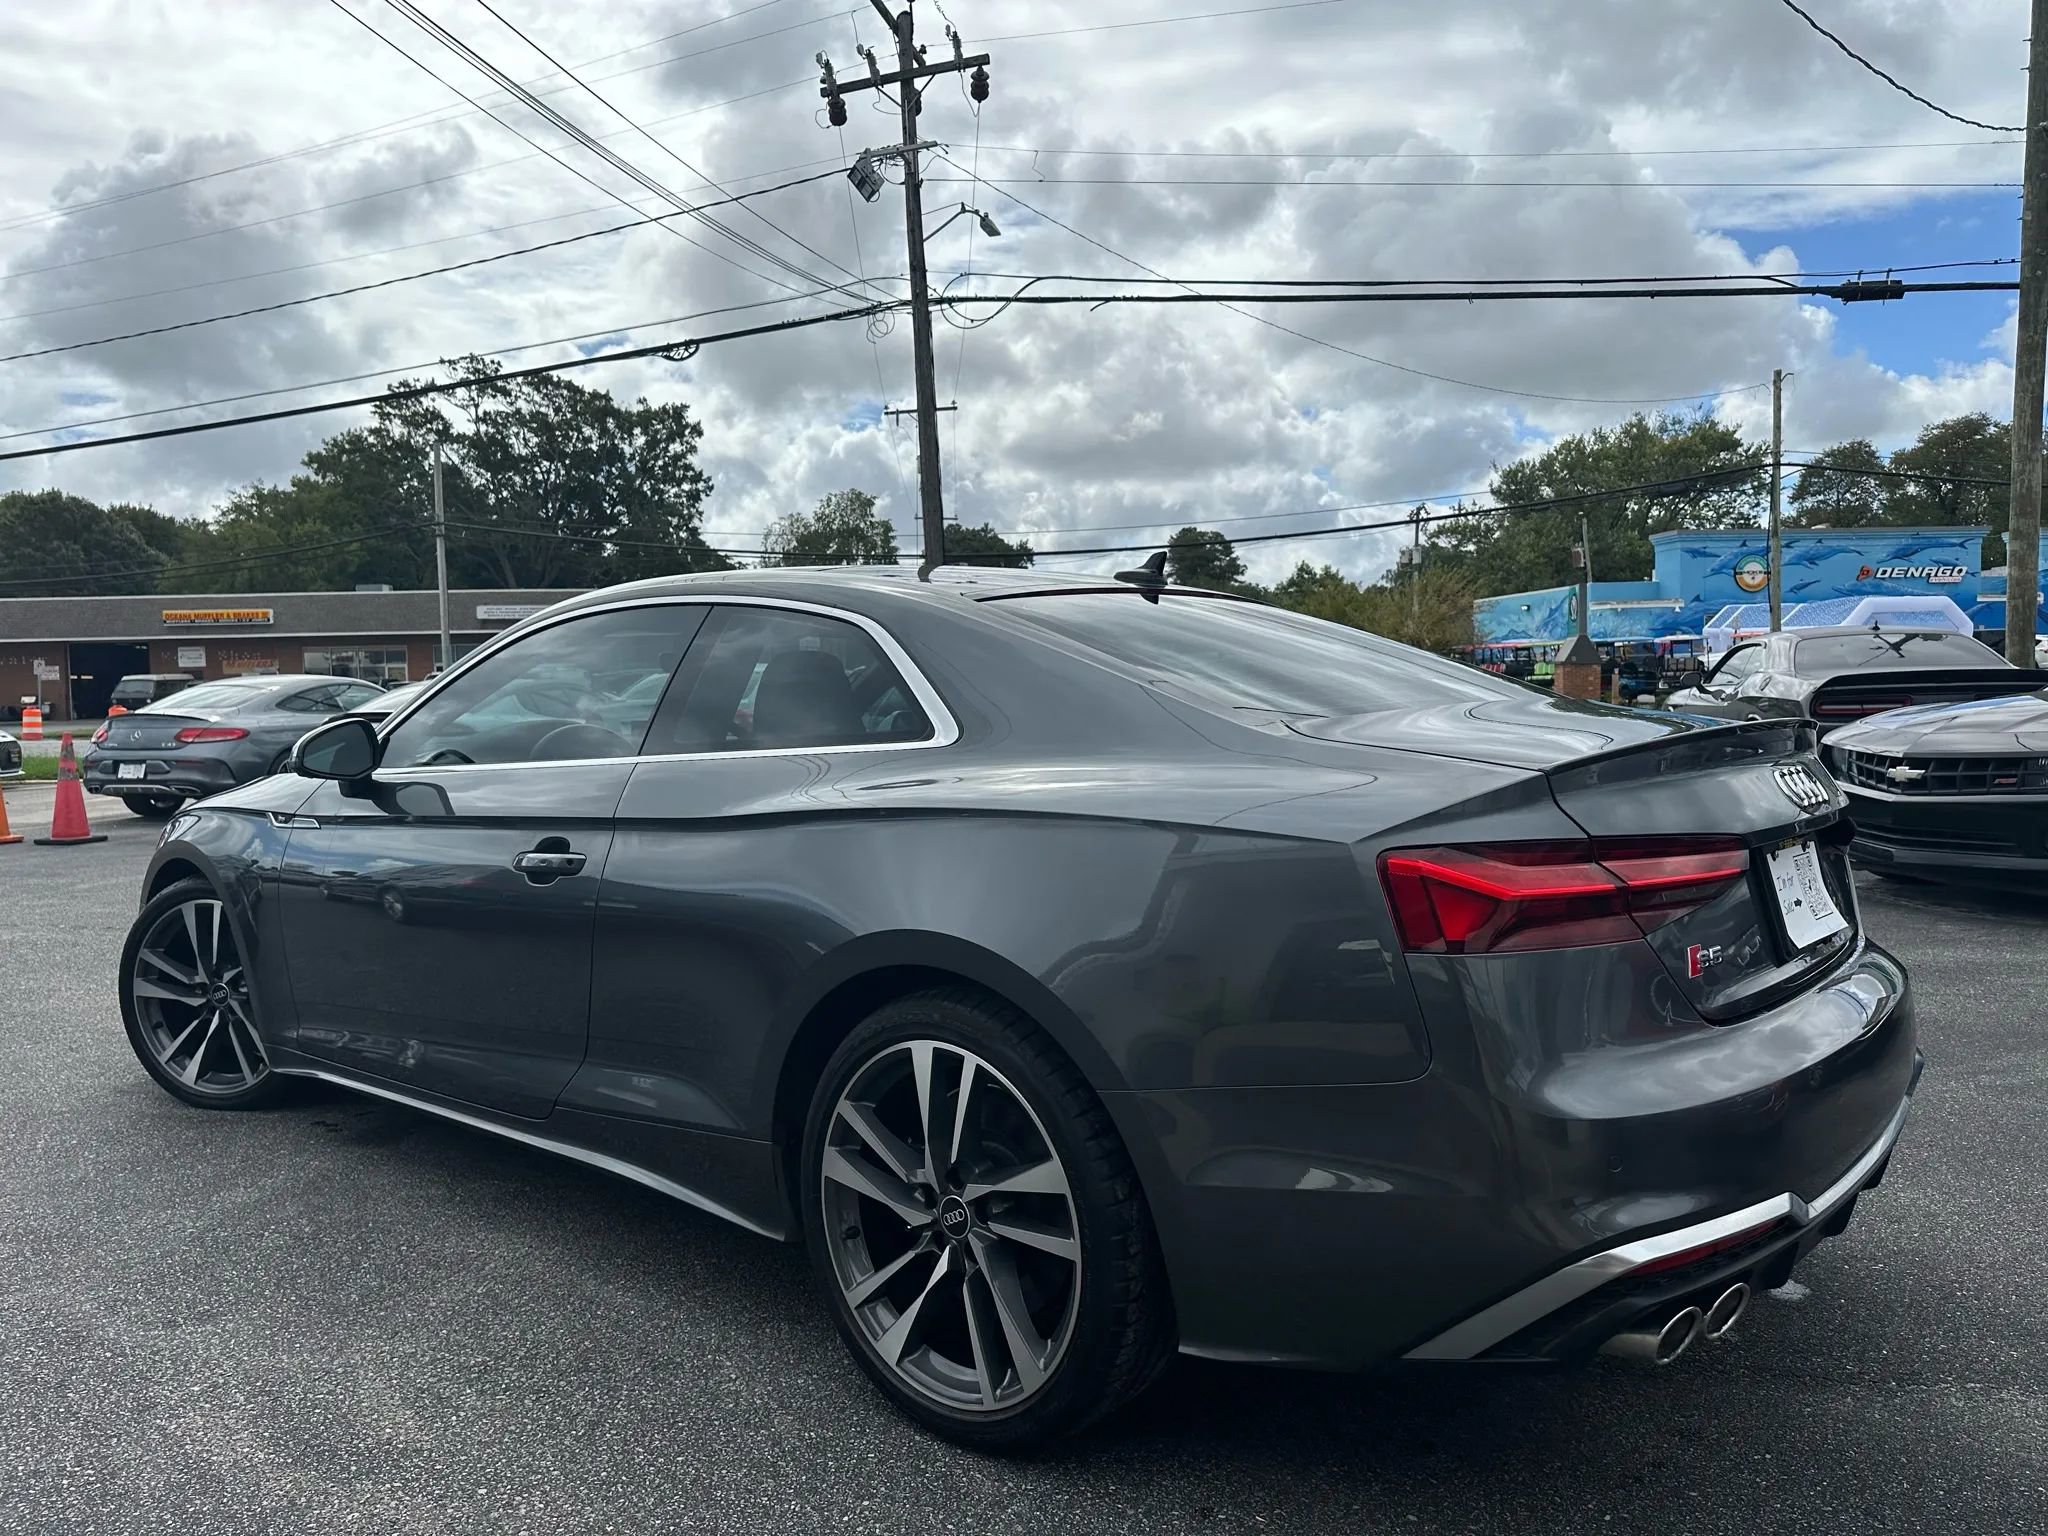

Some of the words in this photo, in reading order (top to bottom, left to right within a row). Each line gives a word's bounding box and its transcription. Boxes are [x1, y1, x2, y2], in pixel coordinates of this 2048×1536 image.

[1875, 566, 1968, 578] DENAGO
[194, 612, 225, 620] MUFFLER
[233, 611, 259, 619] BRAKES
[1697, 945, 1723, 968] S5
